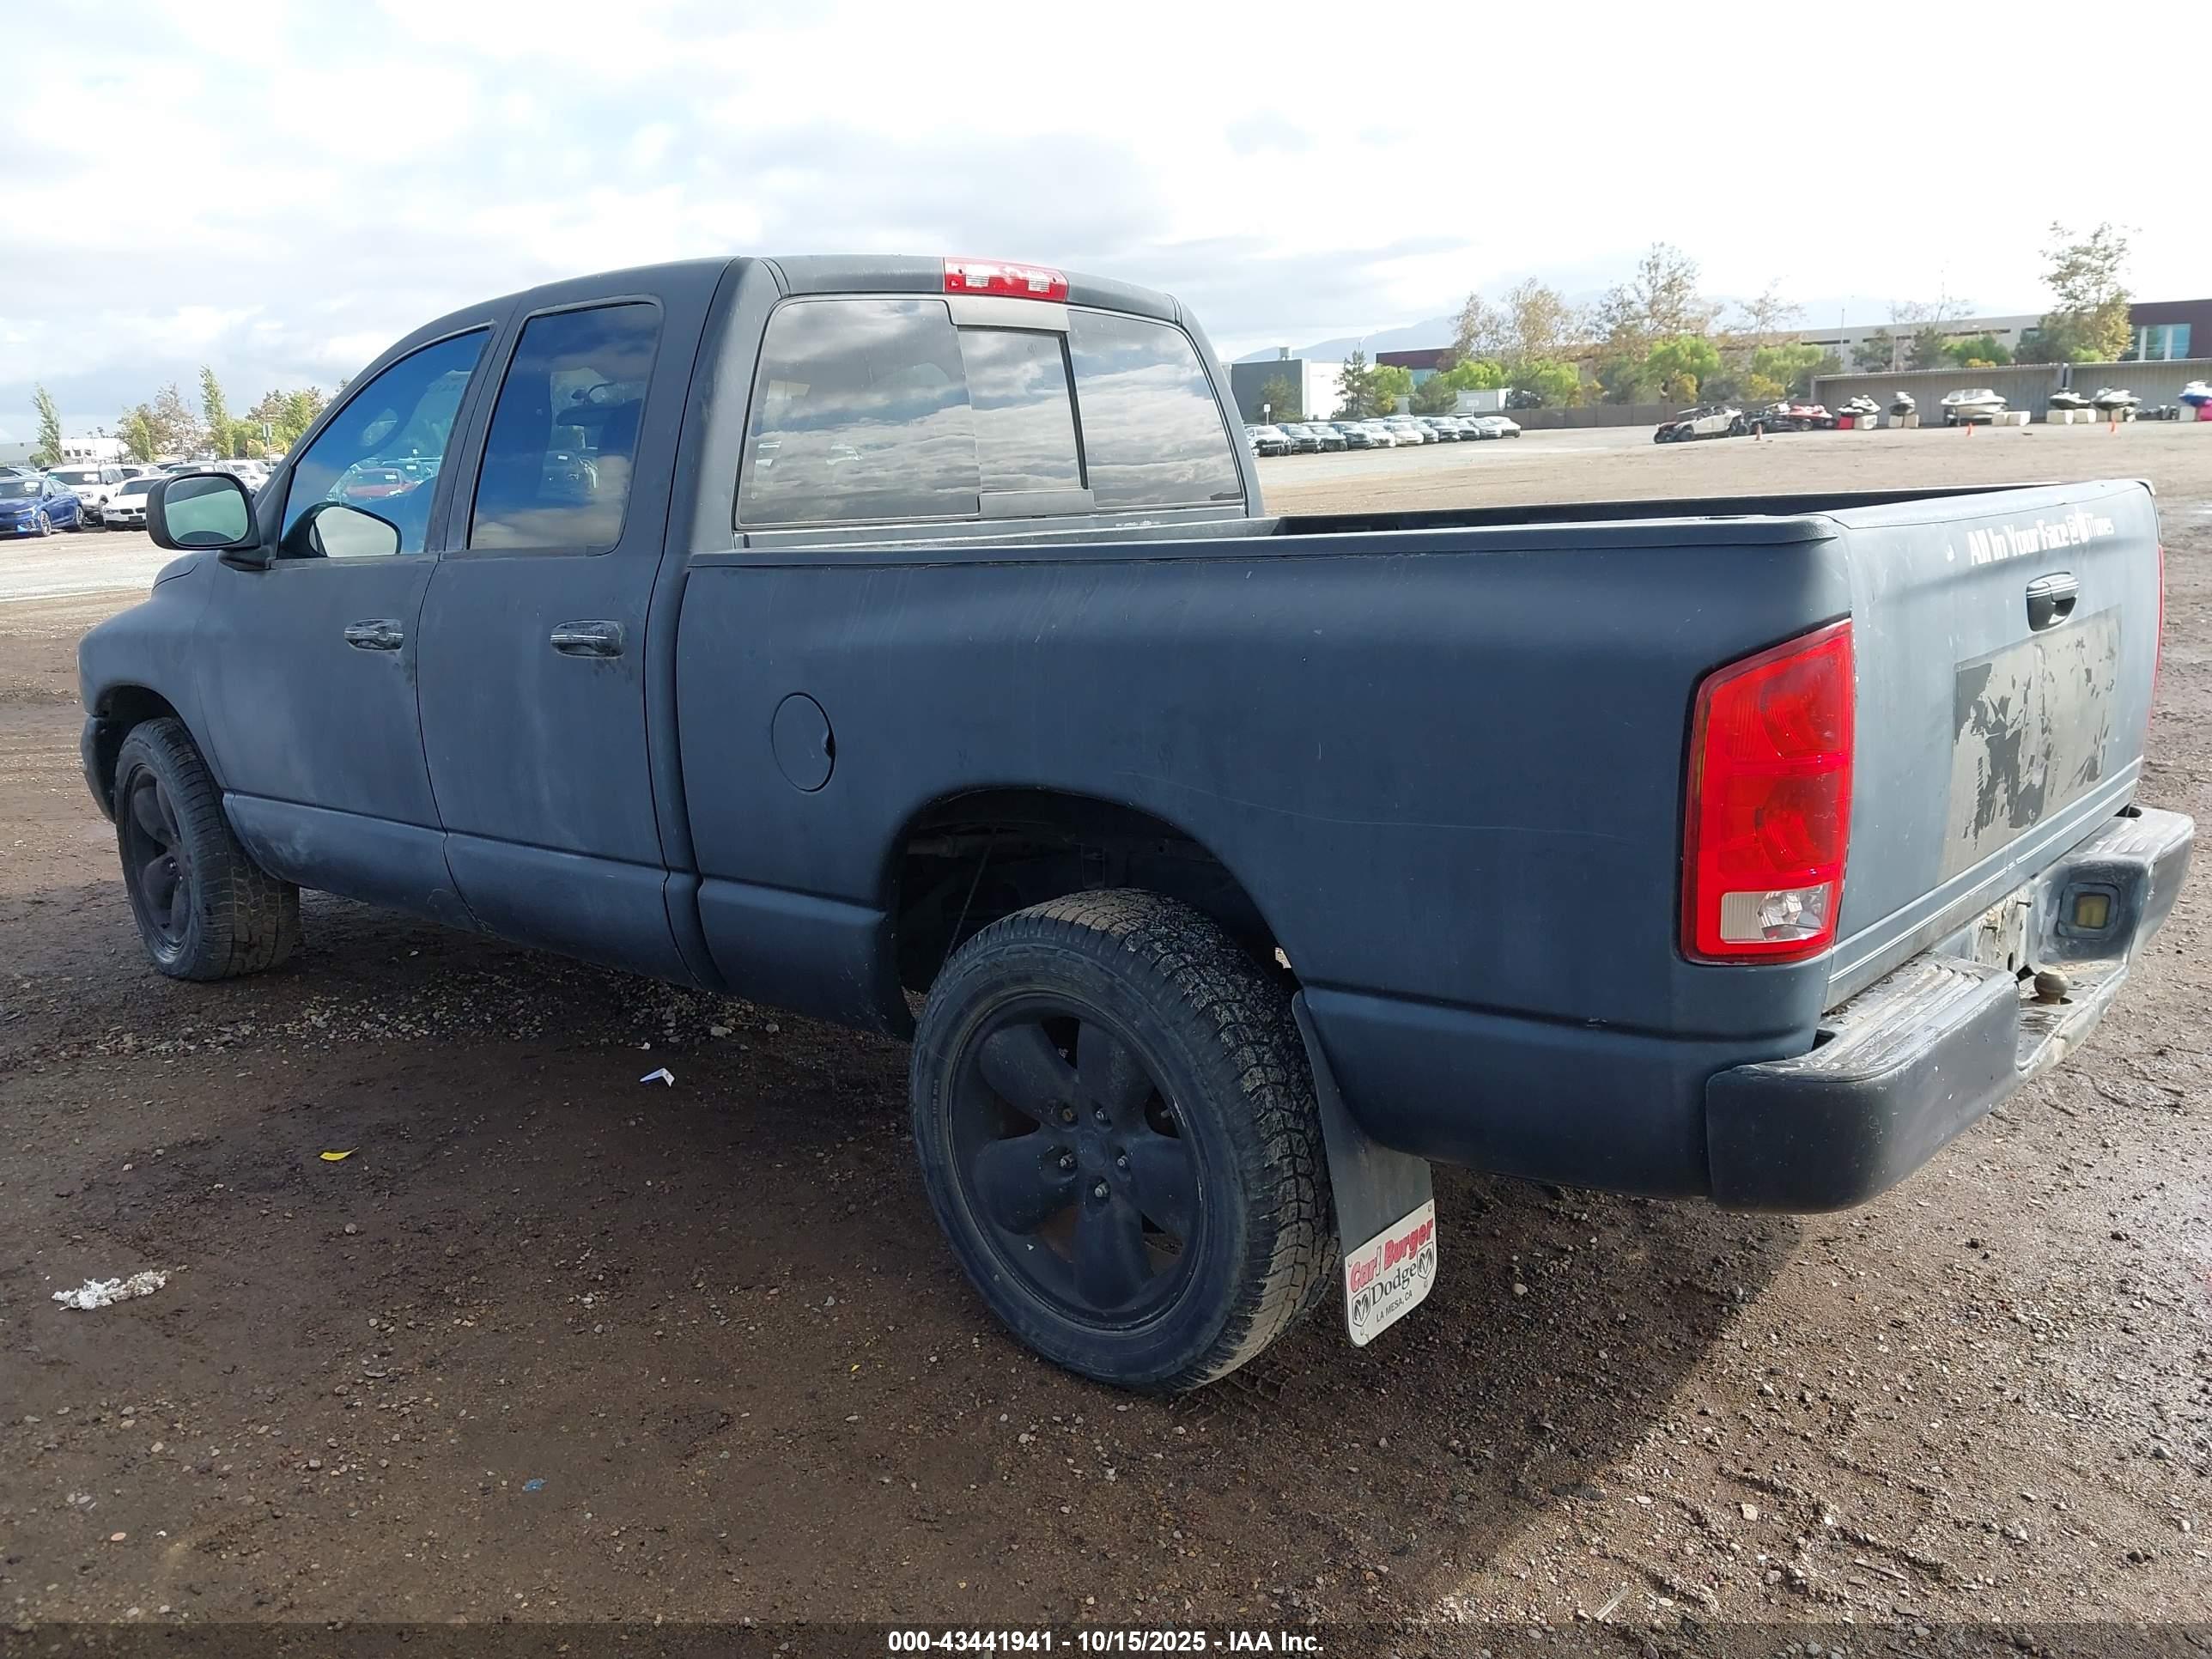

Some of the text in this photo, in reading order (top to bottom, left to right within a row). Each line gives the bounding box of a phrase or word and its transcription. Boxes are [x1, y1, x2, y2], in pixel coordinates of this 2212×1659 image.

[1967, 529, 1992, 566] All
[1986, 527, 2008, 561] In
[2003, 524, 2039, 556] Your
[2036, 519, 2070, 550] Face
[1350, 1218, 1433, 1293] Carl Burger
[1372, 1263, 1417, 1306] Dodge
[1376, 1290, 1413, 1323] LA MESA, CA
